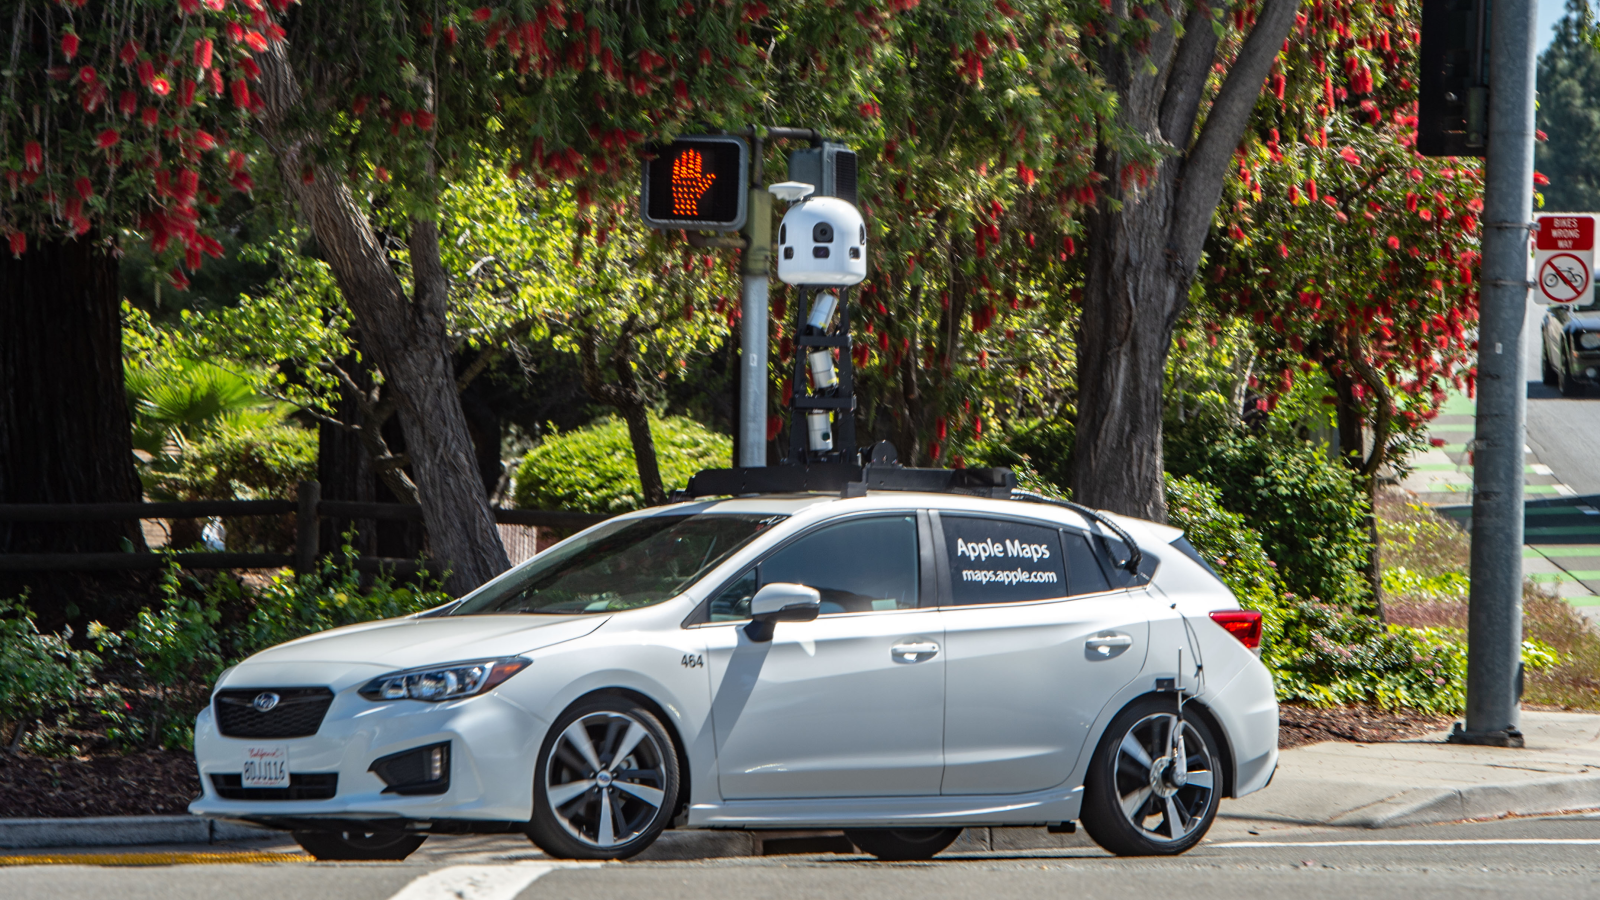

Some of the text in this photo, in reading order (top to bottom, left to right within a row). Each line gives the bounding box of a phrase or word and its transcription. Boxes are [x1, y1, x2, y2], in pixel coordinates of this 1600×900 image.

[1553, 217, 1578, 228] BIKES
[1551, 228, 1580, 239] WRONG
[1557, 239, 1573, 249] WAY
[957, 537, 1050, 563] Apple Maps
[962, 567, 1058, 586] maps.apple.com
[680, 653, 704, 669] 464
